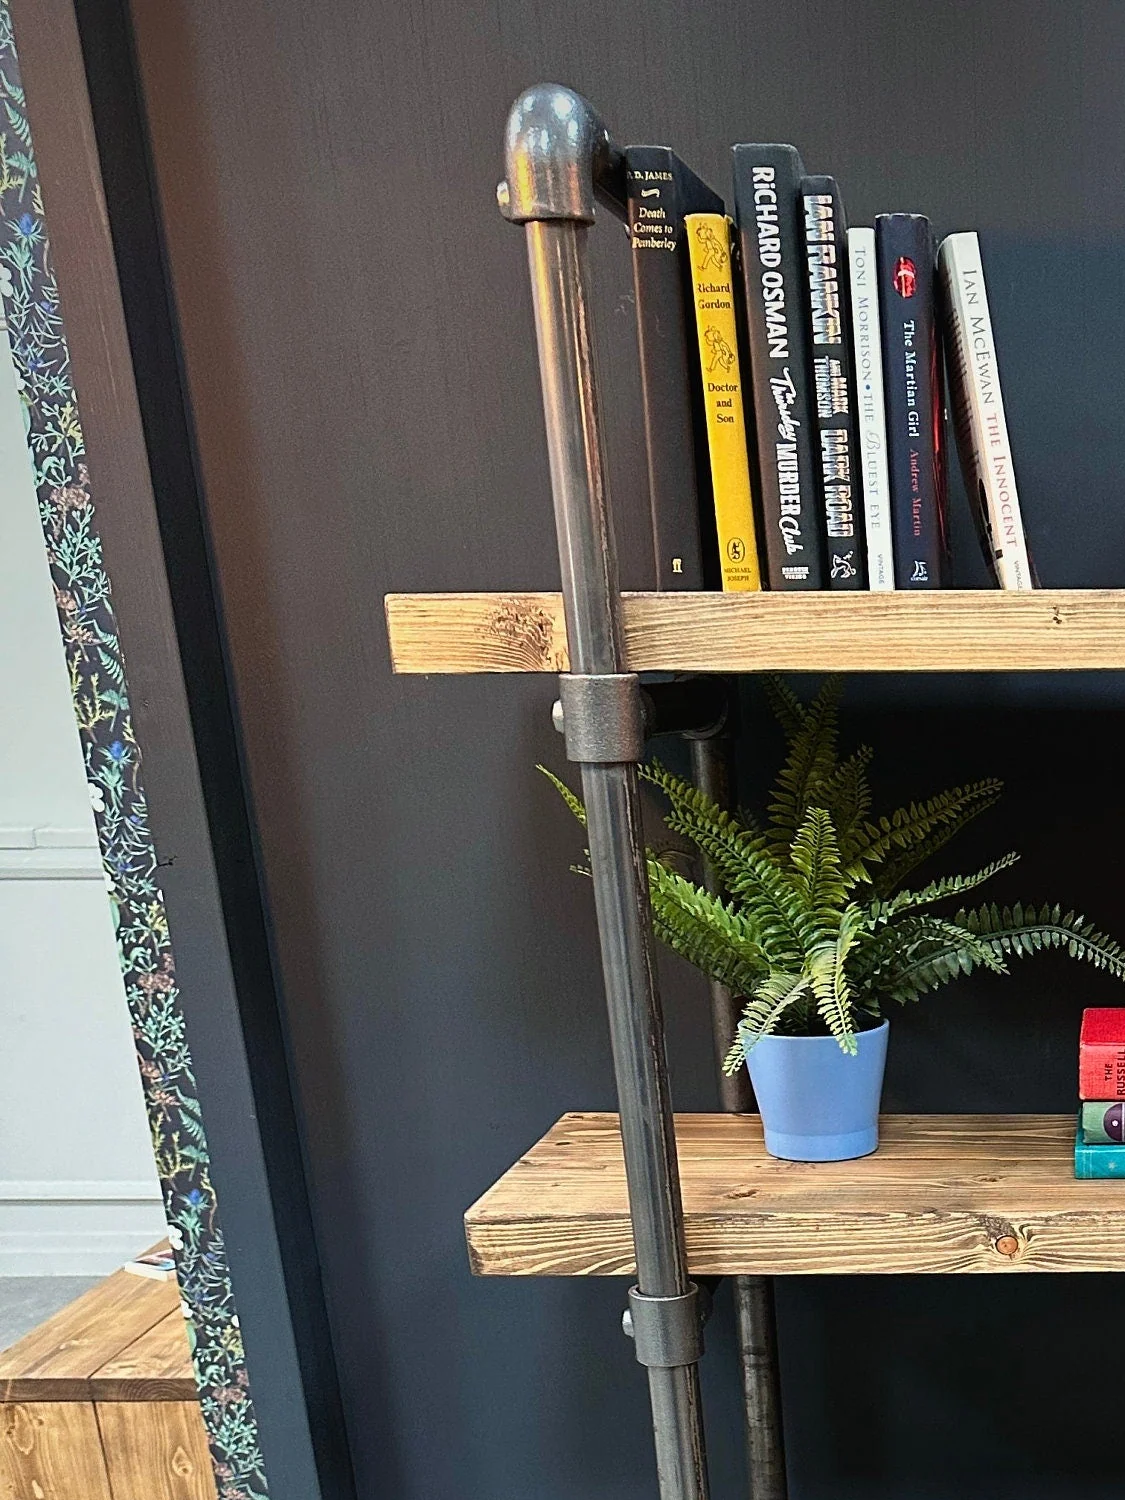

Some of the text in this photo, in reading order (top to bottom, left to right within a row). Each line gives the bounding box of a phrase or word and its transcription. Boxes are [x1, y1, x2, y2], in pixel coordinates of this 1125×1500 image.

[644, 170, 673, 181] JAMES
[633, 222, 673, 234] Comes to
[638, 207, 666, 219] Death
[631, 237, 677, 252] Pemberley
[803, 194, 841, 344] IAN RANKIN
[854, 248, 867, 287] TONI
[698, 283, 731, 293] Richard
[962, 269, 979, 305] IAN
[698, 300, 731, 309] Gordon
[761, 271, 789, 358] OSMAN
[857, 297, 872, 381] MORRISON
[707, 382, 739, 392] Doctor
[813, 355, 833, 418] THOMSON
[830, 377, 849, 415] MARK
[716, 398, 732, 408] and
[716, 414, 734, 424] Son
[863, 394, 874, 421] THE
[903, 319, 922, 536] The Martian Girl Andrew Martin
[986, 413, 1001, 447] THE
[776, 443, 801, 516] MURDER
[820, 428, 854, 537] DARK ROAD
[870, 504, 880, 529] EYE
[993, 455, 1018, 548] INNOCENT
[778, 516, 803, 556] Club
[877, 554, 885, 584] VINTAGE
[1104, 1063, 1113, 1081] THE
